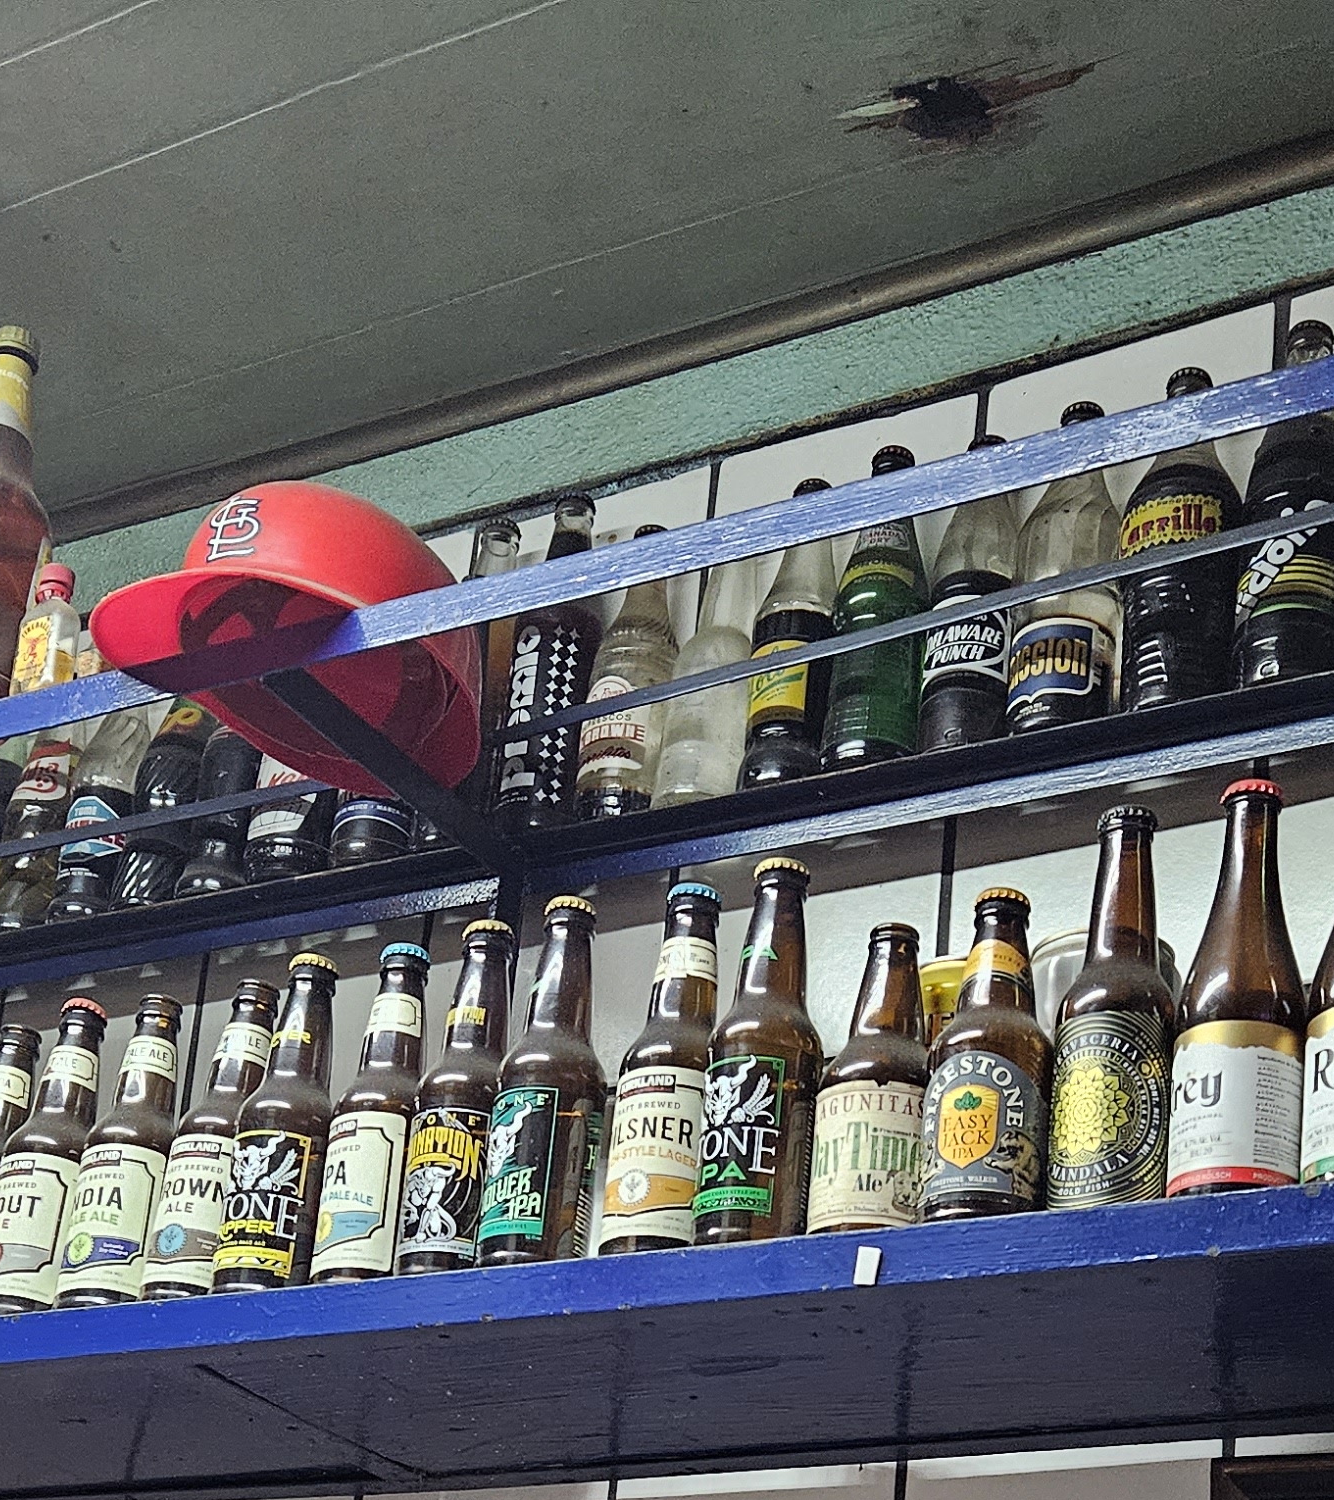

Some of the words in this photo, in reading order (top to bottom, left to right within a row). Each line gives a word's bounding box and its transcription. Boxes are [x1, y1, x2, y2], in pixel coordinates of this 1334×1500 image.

[931, 644, 985, 671] PUNCH
[620, 1074, 677, 1094] KIRKLAND
[923, 1053, 1025, 1136] FIRESTONE
[637, 1101, 681, 1112] BREWED
[942, 1111, 994, 1135] EASY
[940, 1128, 991, 1151] JACK
[951, 1143, 976, 1160] IPA
[1049, 1151, 1130, 1183] MANDALA
[851, 1172, 883, 1195] Ale
[164, 1202, 194, 1214] ALE
